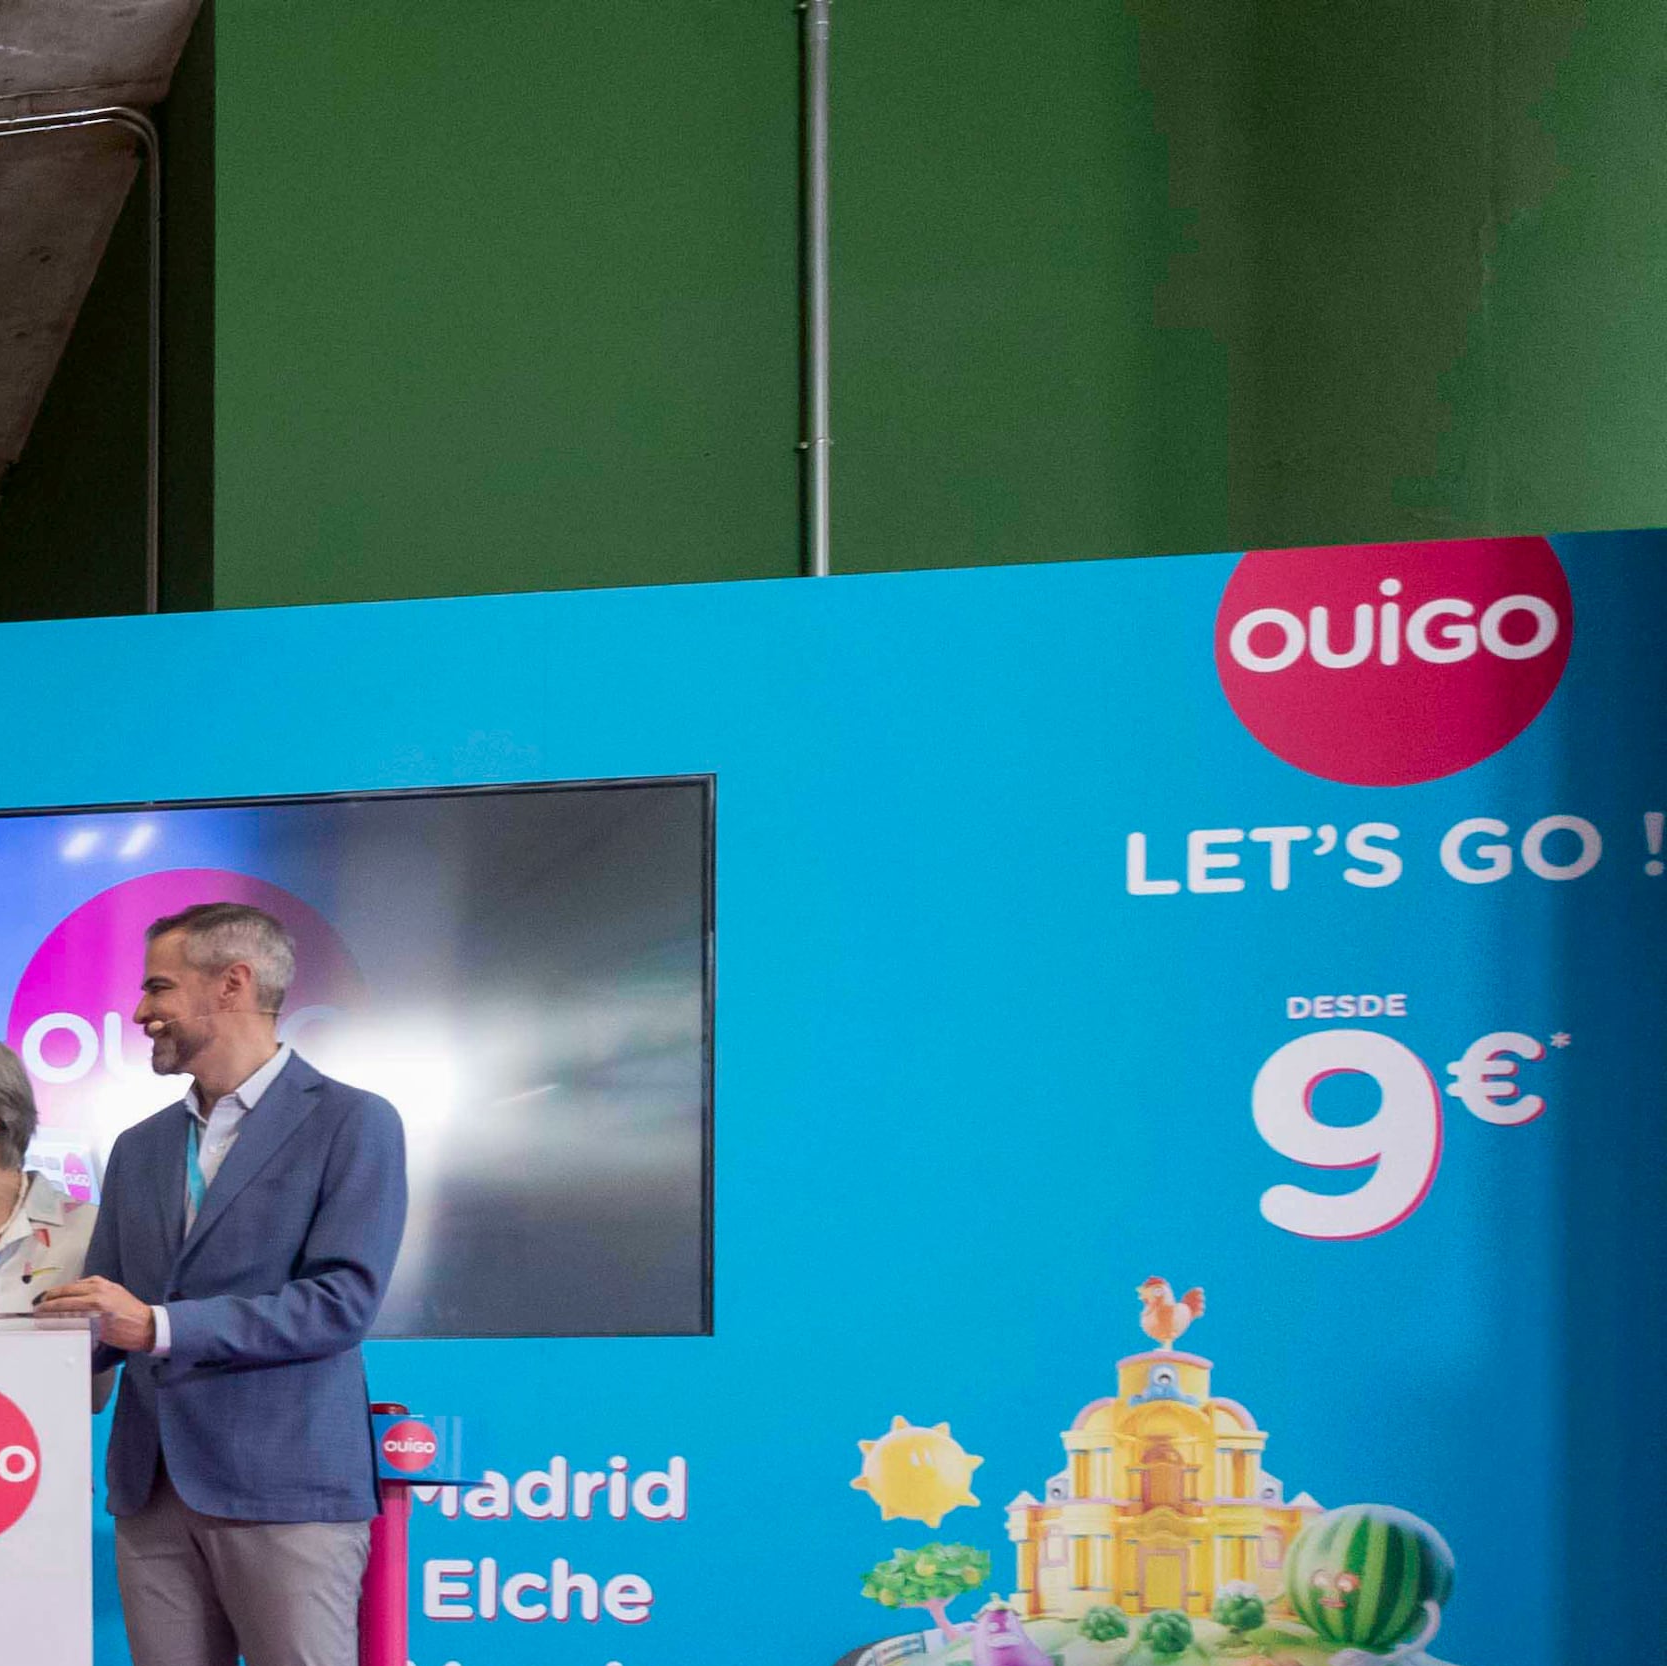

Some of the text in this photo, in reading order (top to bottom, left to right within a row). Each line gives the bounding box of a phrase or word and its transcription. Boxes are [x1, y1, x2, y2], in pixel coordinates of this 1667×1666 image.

[1440, 814, 1603, 884] GO
[1643, 811, 1665, 877] !
[1286, 993, 1408, 1020] DESDE
[423, 1557, 655, 1624] Elche
